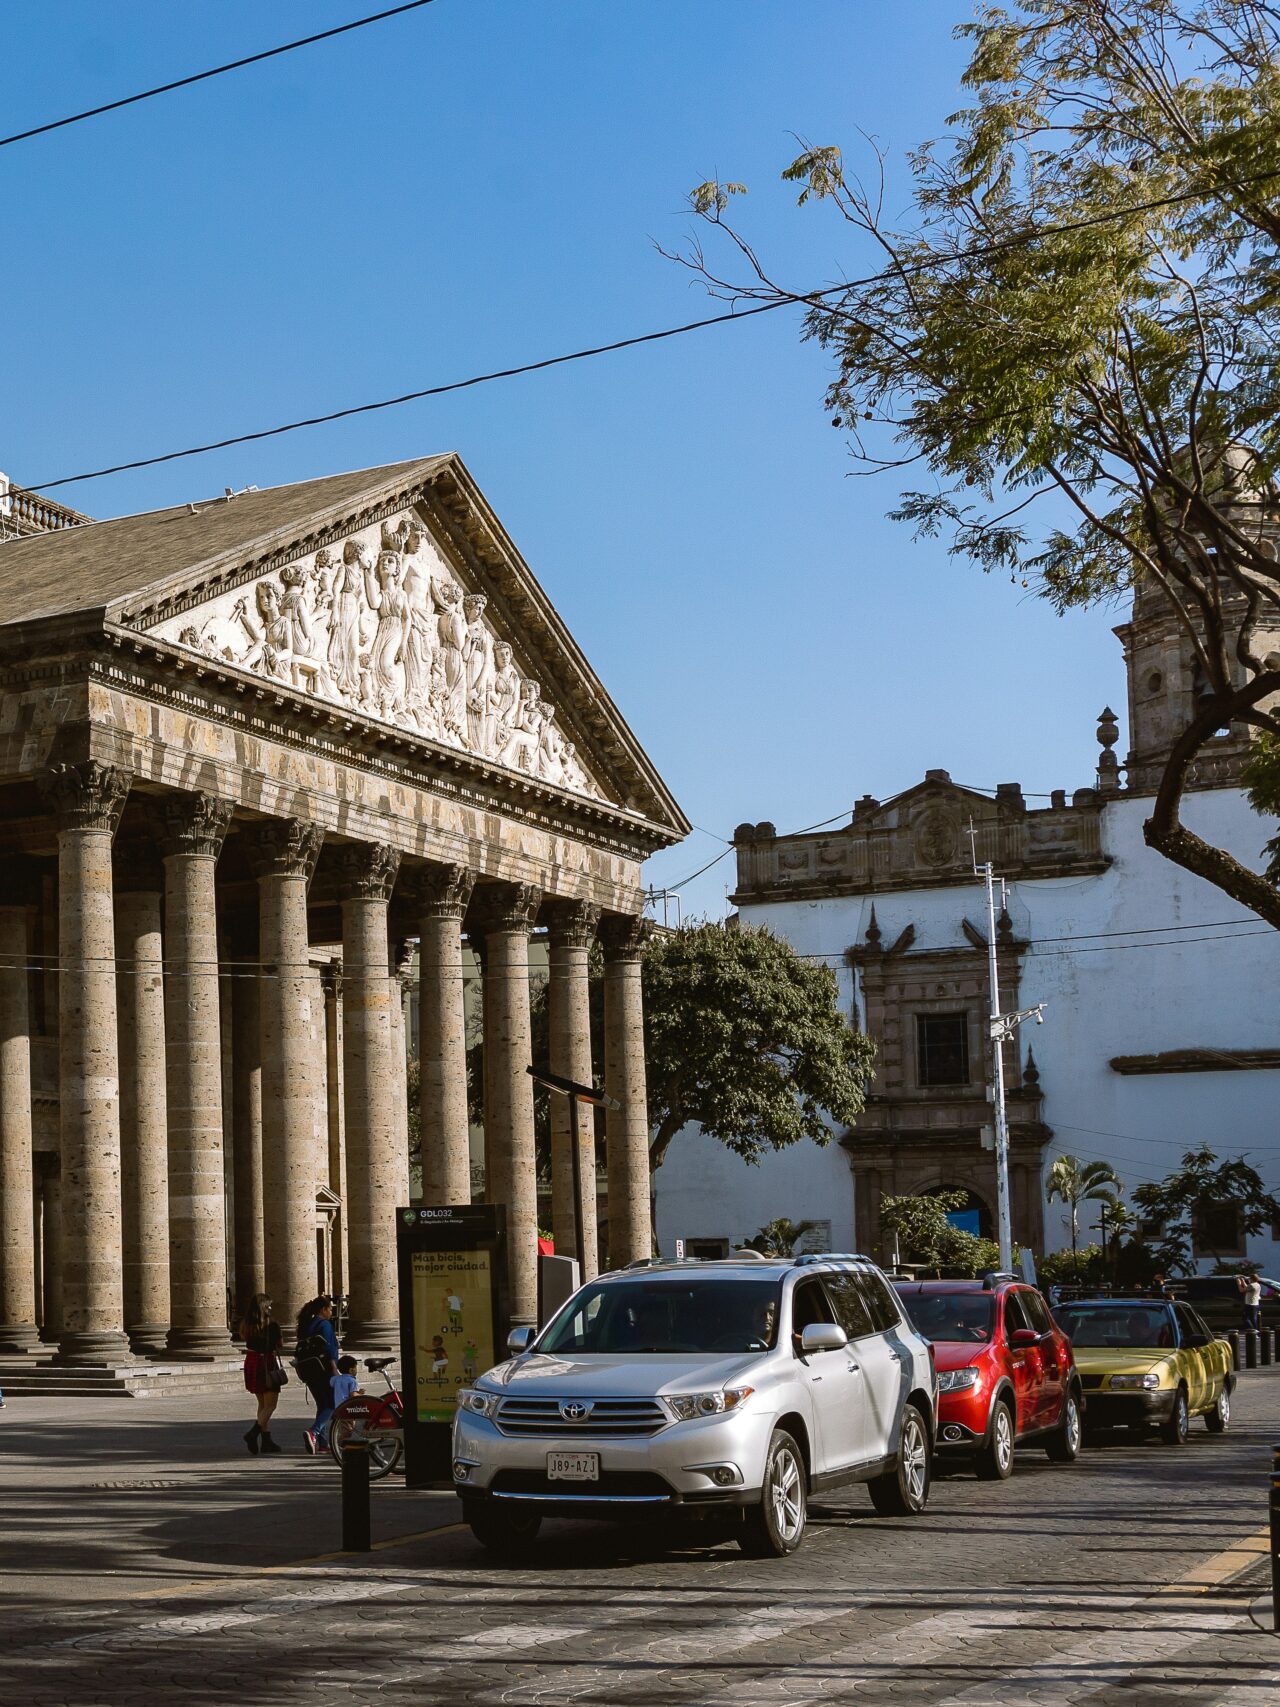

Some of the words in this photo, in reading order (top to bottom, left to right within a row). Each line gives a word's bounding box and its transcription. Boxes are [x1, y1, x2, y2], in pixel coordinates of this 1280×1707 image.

[420, 1209, 453, 1218] GDL032
[437, 1252, 466, 1263] bicis,
[414, 1262, 446, 1273] mejor
[447, 1261, 489, 1271] ciudad.
[551, 1460, 595, 1472] J89-AZJ
